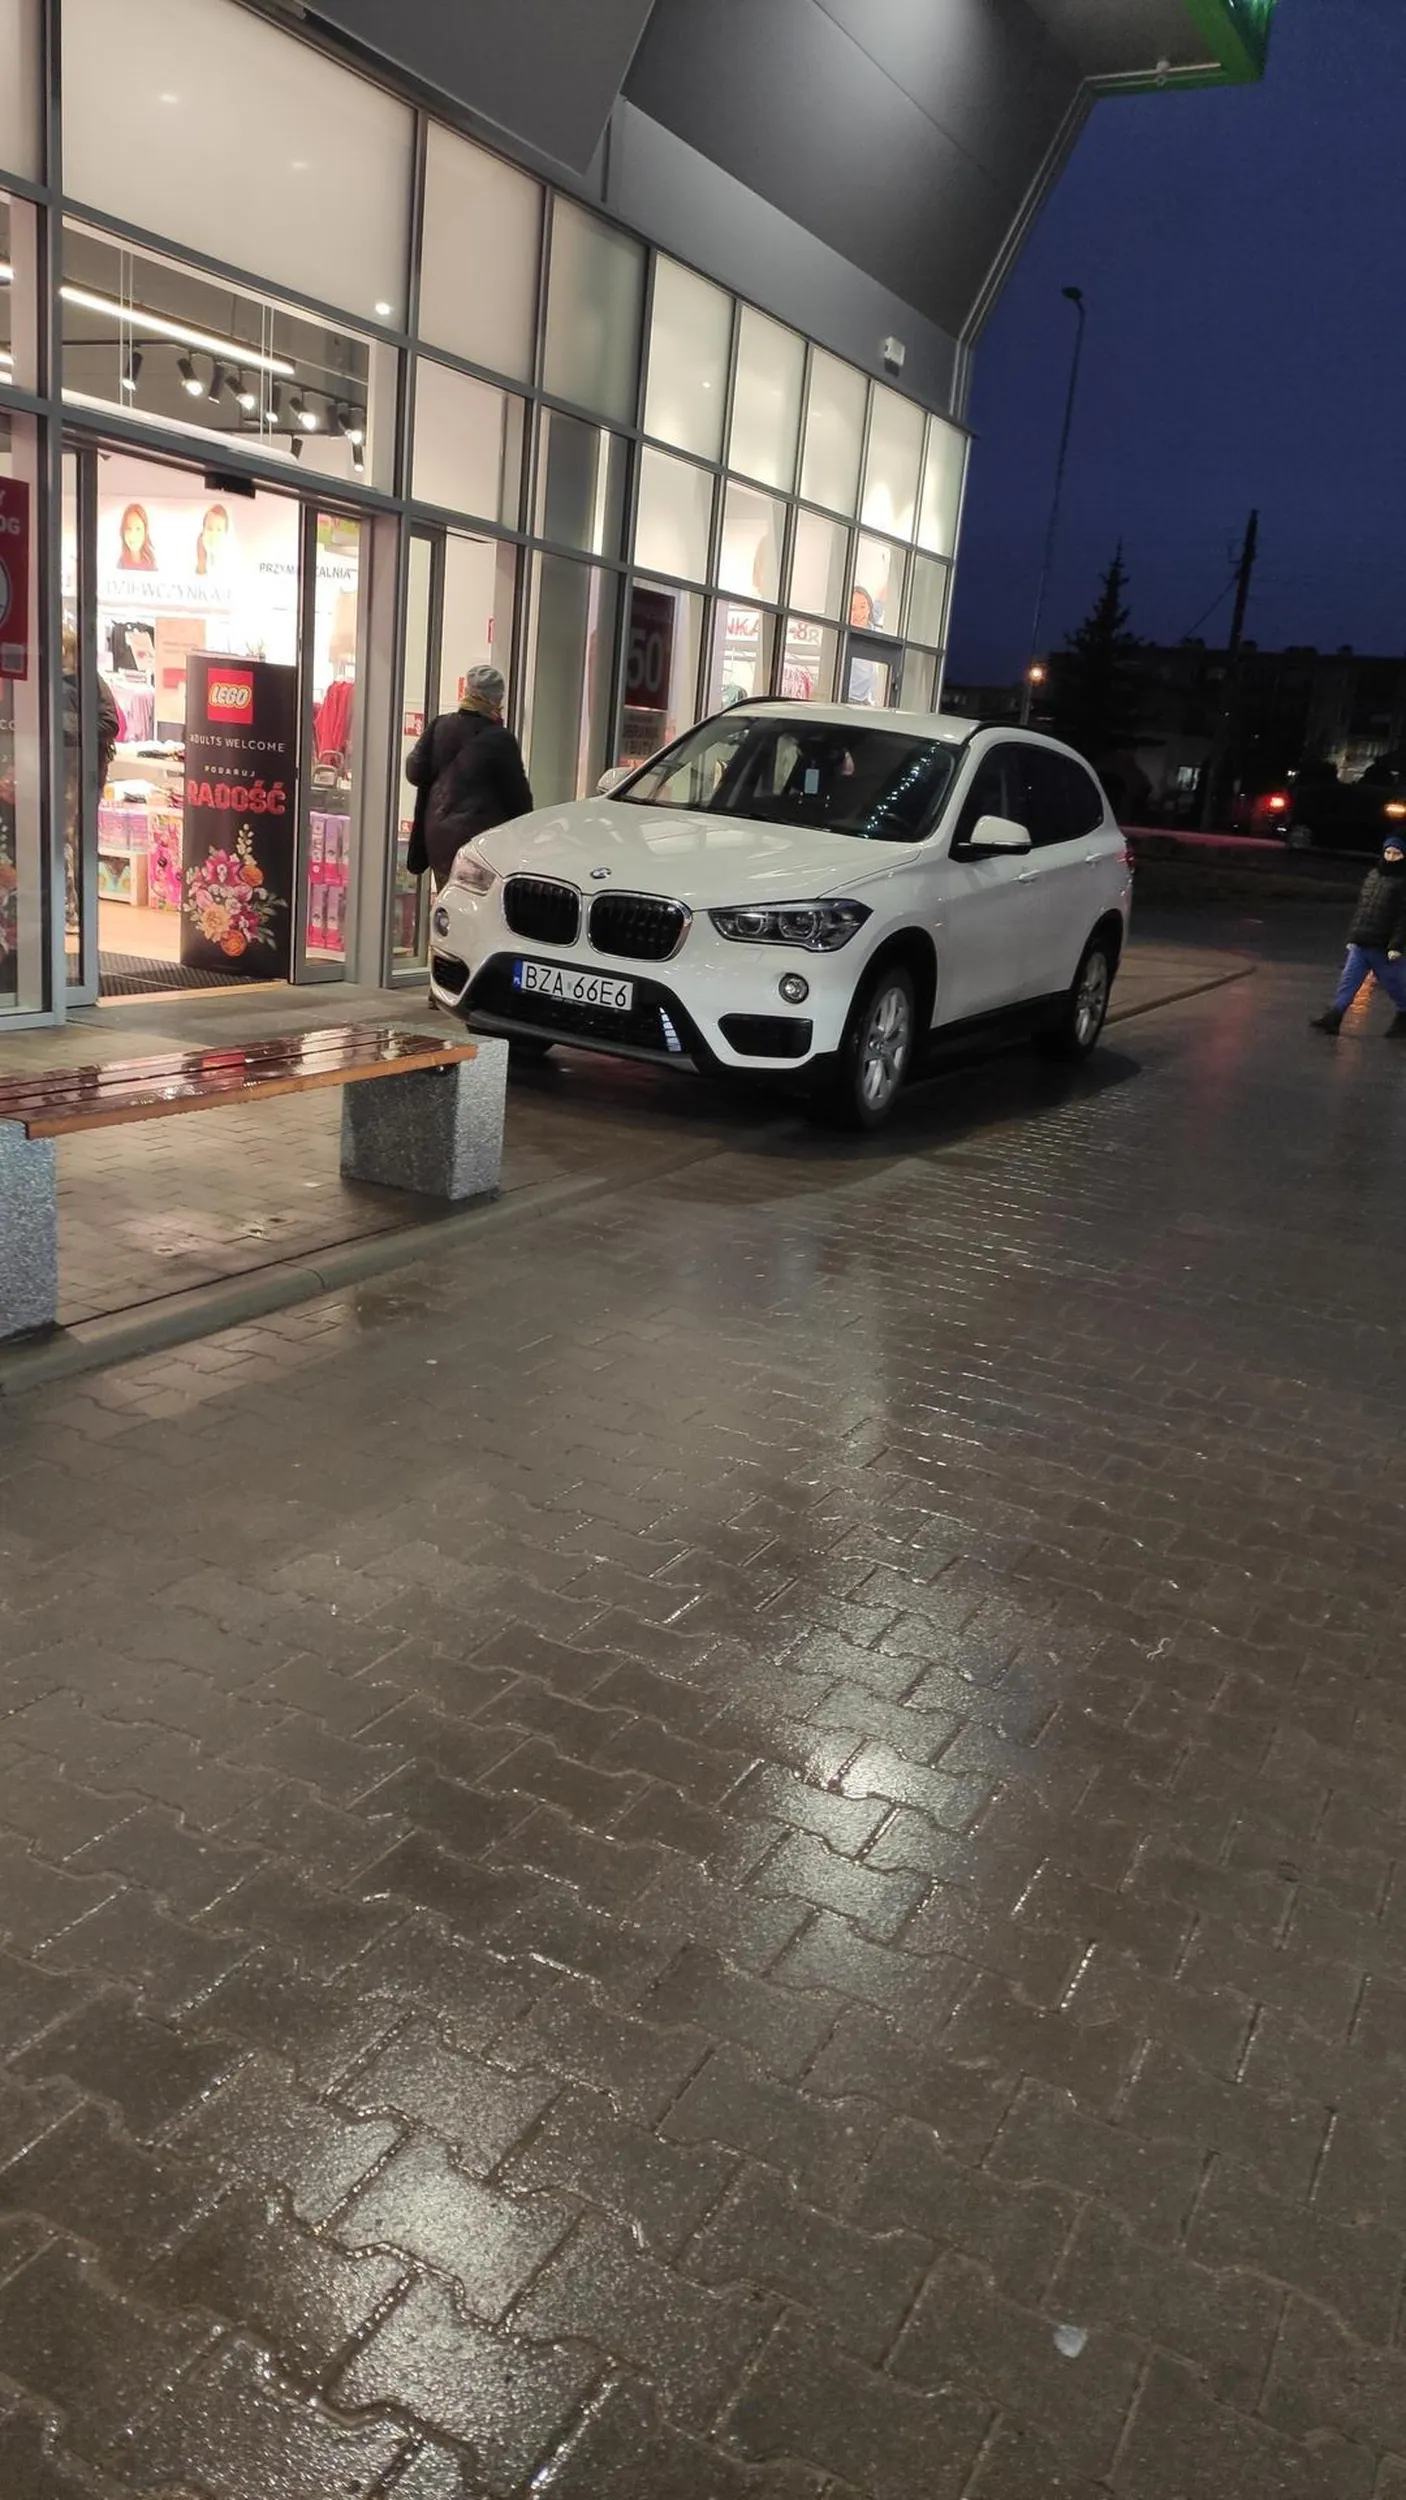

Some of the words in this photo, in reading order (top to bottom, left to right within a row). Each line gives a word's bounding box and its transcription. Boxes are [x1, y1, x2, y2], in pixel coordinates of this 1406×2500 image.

[210, 683, 251, 708] LEGO
[189, 733, 222, 747] ADULTS
[225, 738, 286, 753] WELCOME
[204, 765, 256, 777] PODARUJ
[187, 779, 287, 815] RADOŚĆ
[525, 965, 564, 996] BZA
[573, 976, 627, 1007] 66E6
